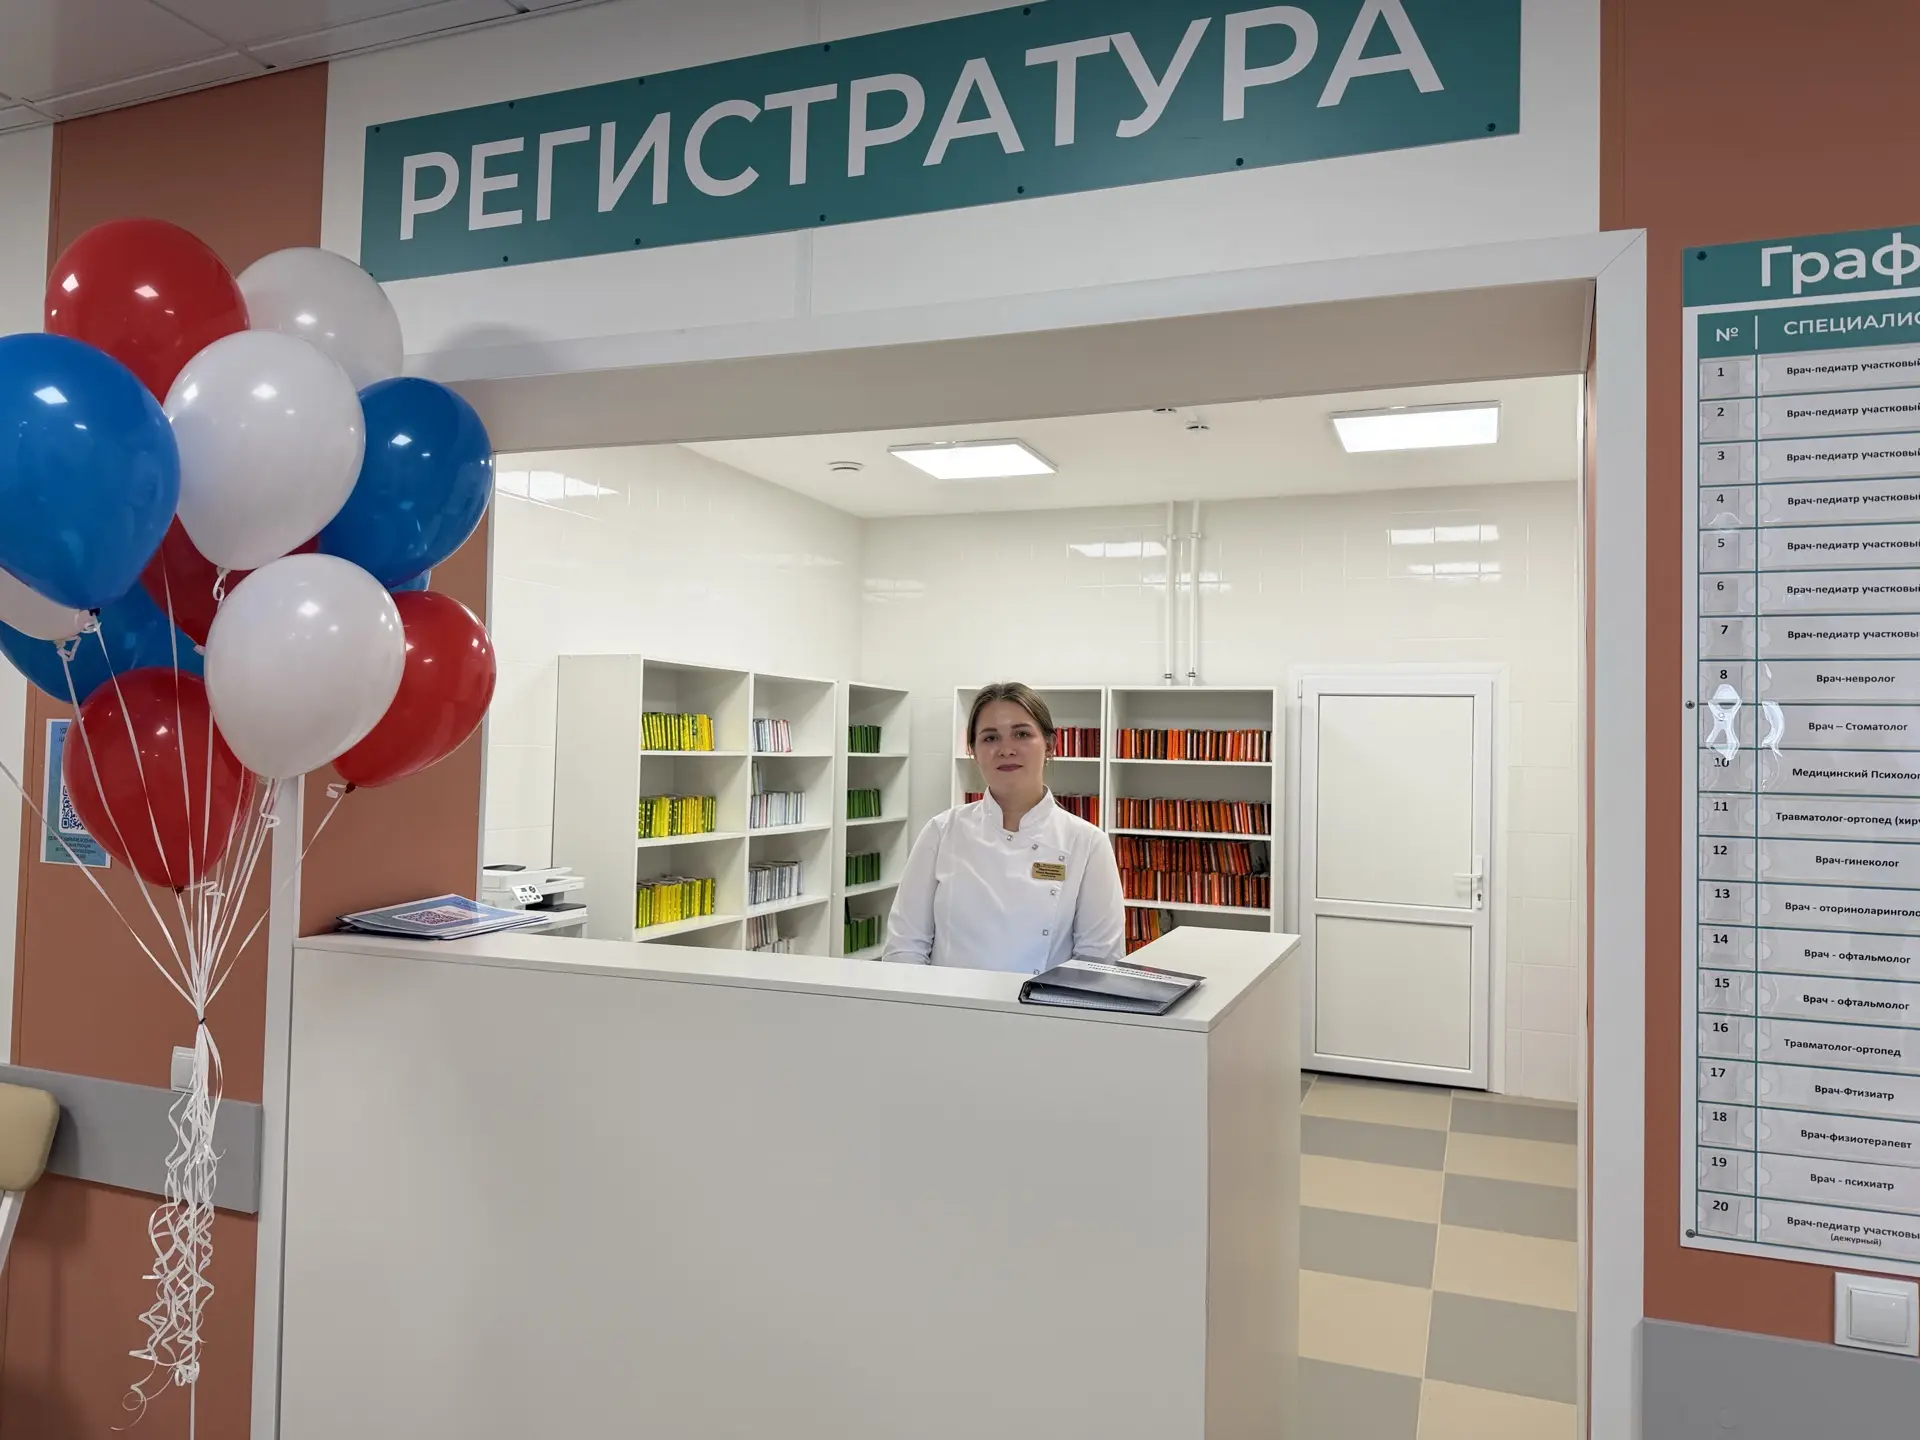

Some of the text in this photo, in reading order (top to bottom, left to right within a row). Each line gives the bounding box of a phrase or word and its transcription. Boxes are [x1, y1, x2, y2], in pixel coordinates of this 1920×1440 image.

[400, 0, 1445, 240] РЕГИСТРАТУРА
[1716, 327, 1739, 342] №
[1717, 368, 1725, 377] 1
[1786, 365, 1859, 377] Врач-педиатр
[1716, 407, 1725, 417] 2
[1786, 408, 1859, 419] Врач-педиатр
[1717, 451, 1725, 461] 3
[1786, 453, 1859, 463] Врач-педиатр
[1716, 494, 1920, 507] 4 Врач-педиатр участковы
[1717, 539, 1920, 552] 5 Врач-педиатр участковы
[1716, 581, 1920, 596] 6 Врач-педиатр участковы
[1720, 625, 1920, 641] 7 Врач-педиатр участковы
[1719, 670, 1896, 685] 8 Врач-невролог
[1808, 723, 1834, 732] Врач
[1845, 723, 1908, 731] Стоматолог
[1714, 758, 1730, 768] 10
[1792, 769, 1868, 779] Медицинский
[1713, 802, 1920, 827] 11 Травматолог-ортопед (хир
[1713, 845, 1900, 868] 12 Врач-гинеколог
[1714, 889, 1731, 899] 13
[1785, 902, 1810, 912] Врач
[1713, 934, 1729, 944] 14
[1804, 949, 1830, 960] Врач
[1838, 952, 1911, 964] офтальмолог
[1714, 978, 1730, 989] 15
[1803, 995, 1829, 1005] Врач
[1837, 998, 1910, 1011] офтальмолог
[1712, 1023, 1902, 1058] 16 Травматолог-ортопед
[1710, 1068, 1895, 1102] 17 Врач-Фтизиатр
[1712, 1112, 1912, 1149] 18 Врач-физиотерапевт
[1711, 1157, 1727, 1168] 19
[1810, 1174, 1836, 1184] Врач
[1844, 1179, 1895, 1192] психиатр
[1712, 1200, 1729, 1212] 20
[1786, 1217, 1861, 1236] Врач-педиатр
[1830, 1233, 1882, 1246] (дежурный)
